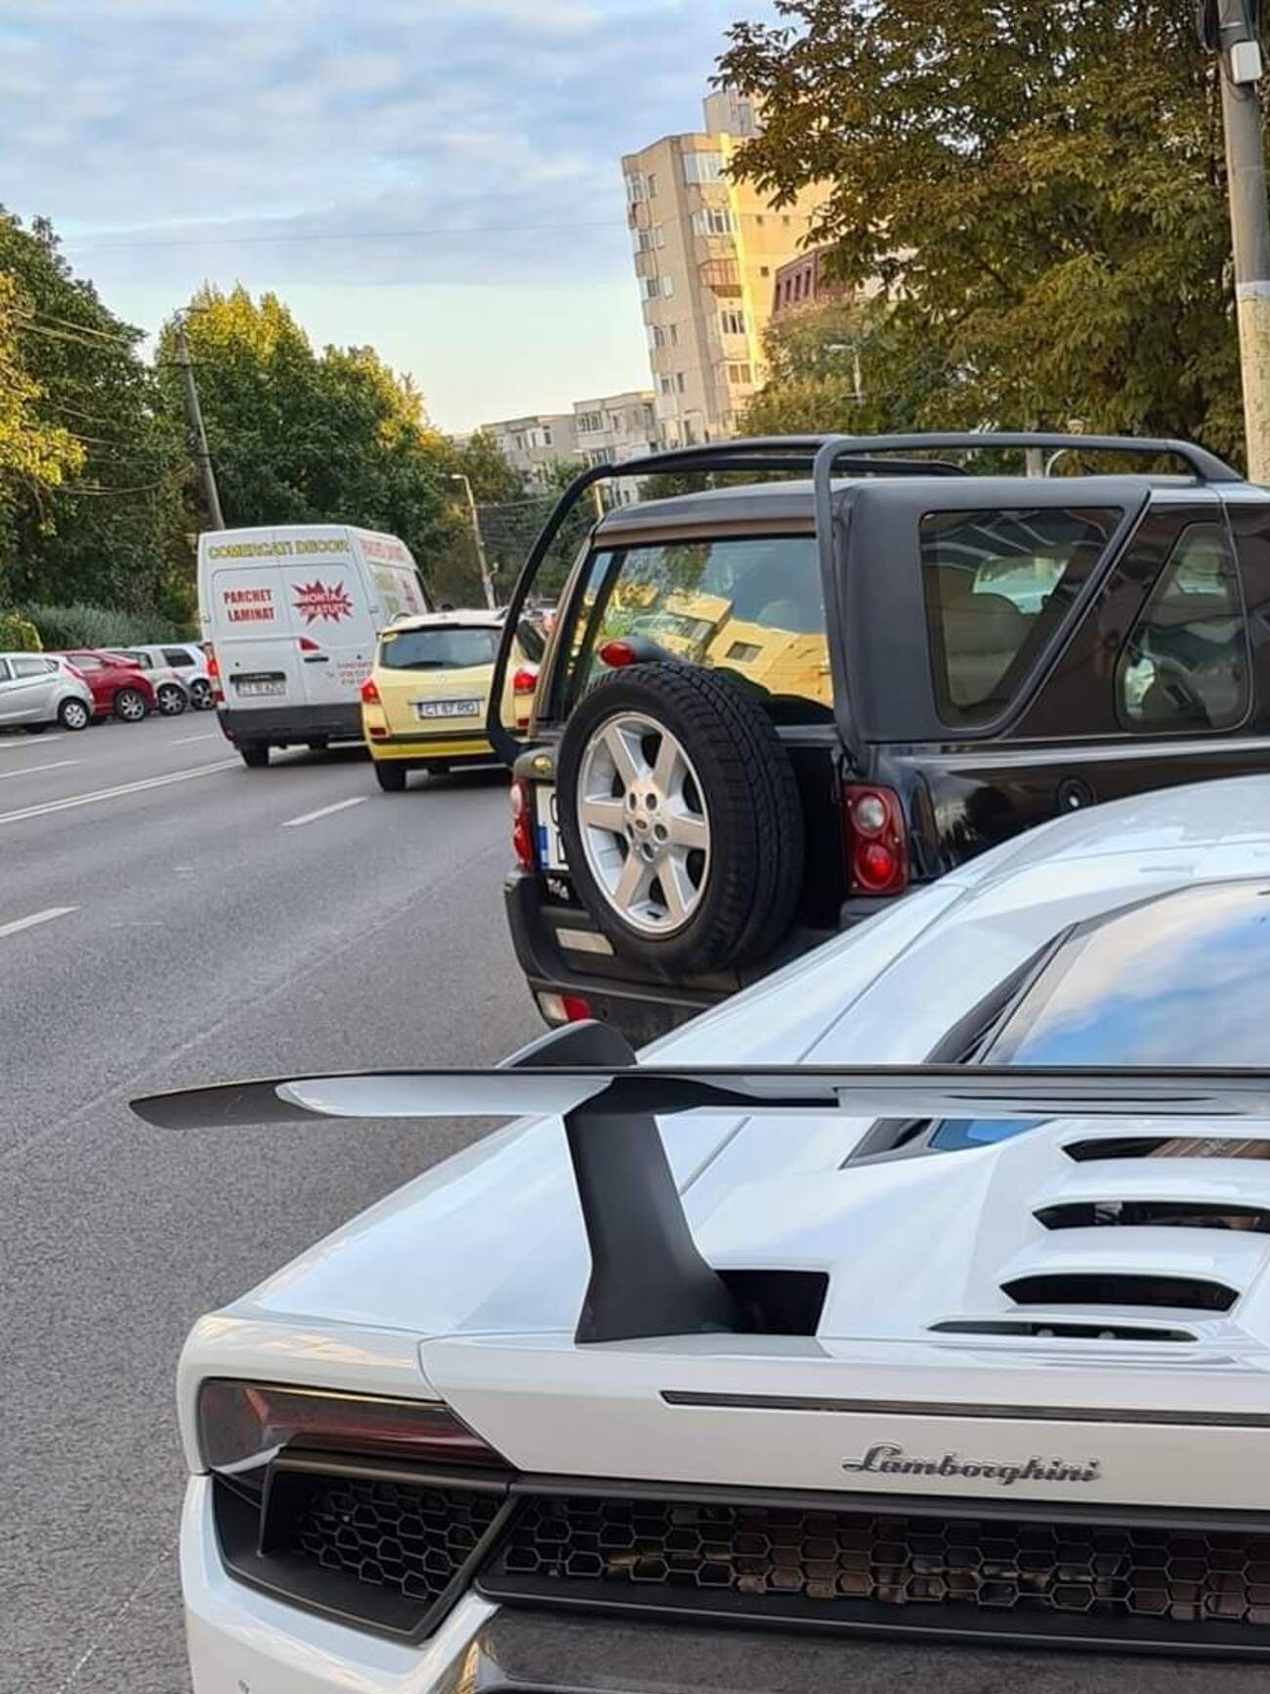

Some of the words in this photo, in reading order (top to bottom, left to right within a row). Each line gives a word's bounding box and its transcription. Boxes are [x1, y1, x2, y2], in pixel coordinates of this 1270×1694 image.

[223, 589, 272, 604] PARCHET
[228, 607, 274, 622] LAMINAT
[842, 1442, 1100, 1486] Lamborghini
